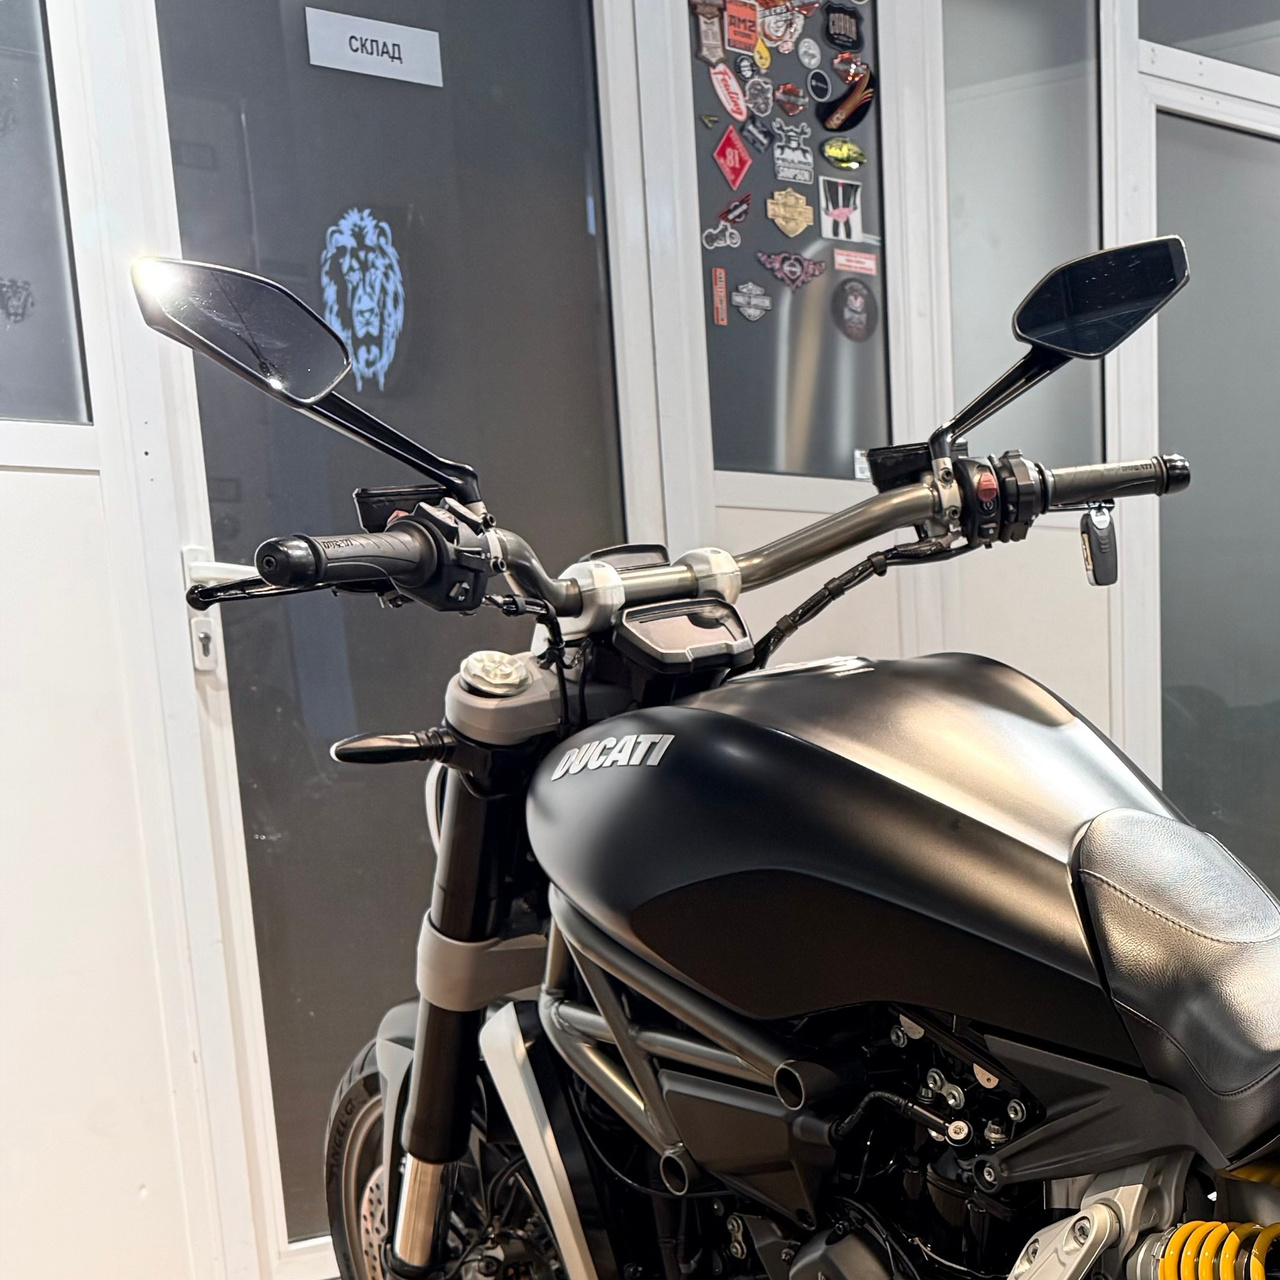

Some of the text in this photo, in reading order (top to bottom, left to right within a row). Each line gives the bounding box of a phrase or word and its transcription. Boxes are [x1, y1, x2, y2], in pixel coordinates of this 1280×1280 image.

[348, 35, 403, 65] СКЛАД
[725, 147, 741, 168] 81
[551, 734, 676, 782] DUCATI
